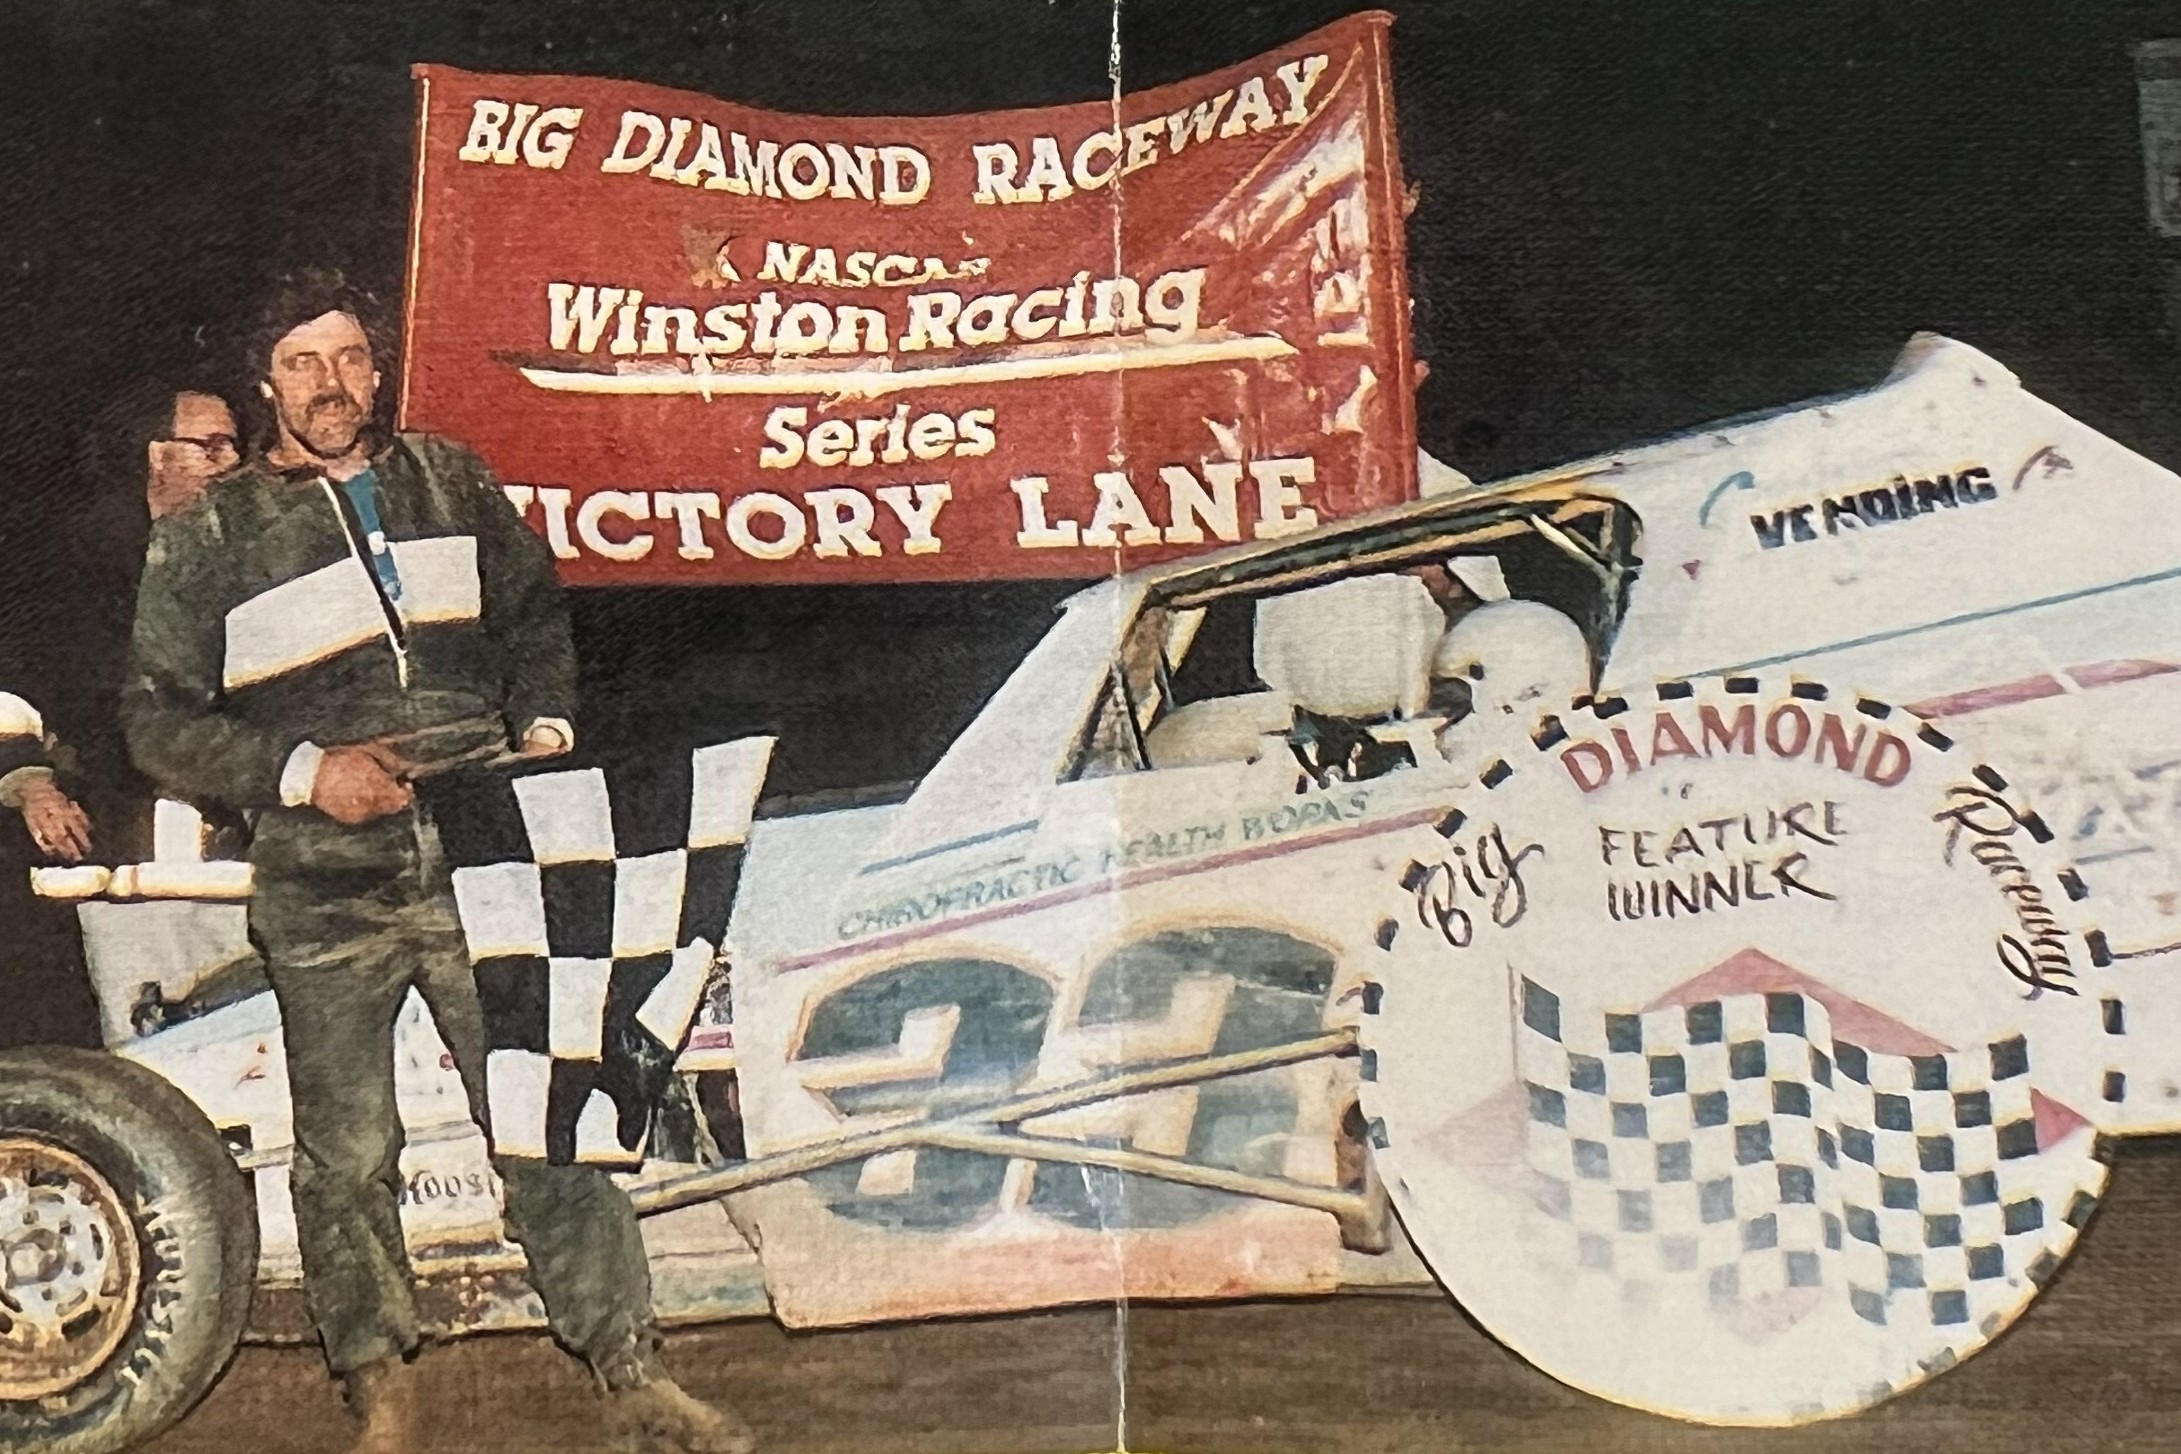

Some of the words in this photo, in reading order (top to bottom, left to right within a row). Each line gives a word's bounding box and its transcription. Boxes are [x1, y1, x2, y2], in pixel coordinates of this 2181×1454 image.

[459, 99, 583, 169] BIG
[601, 109, 933, 206] DIAMOND
[972, 54, 1330, 205] RACEWAY
[547, 283, 889, 355] Winston
[899, 267, 1207, 353] Racing
[760, 403, 997, 470] Series
[1010, 456, 1319, 549] LANE
